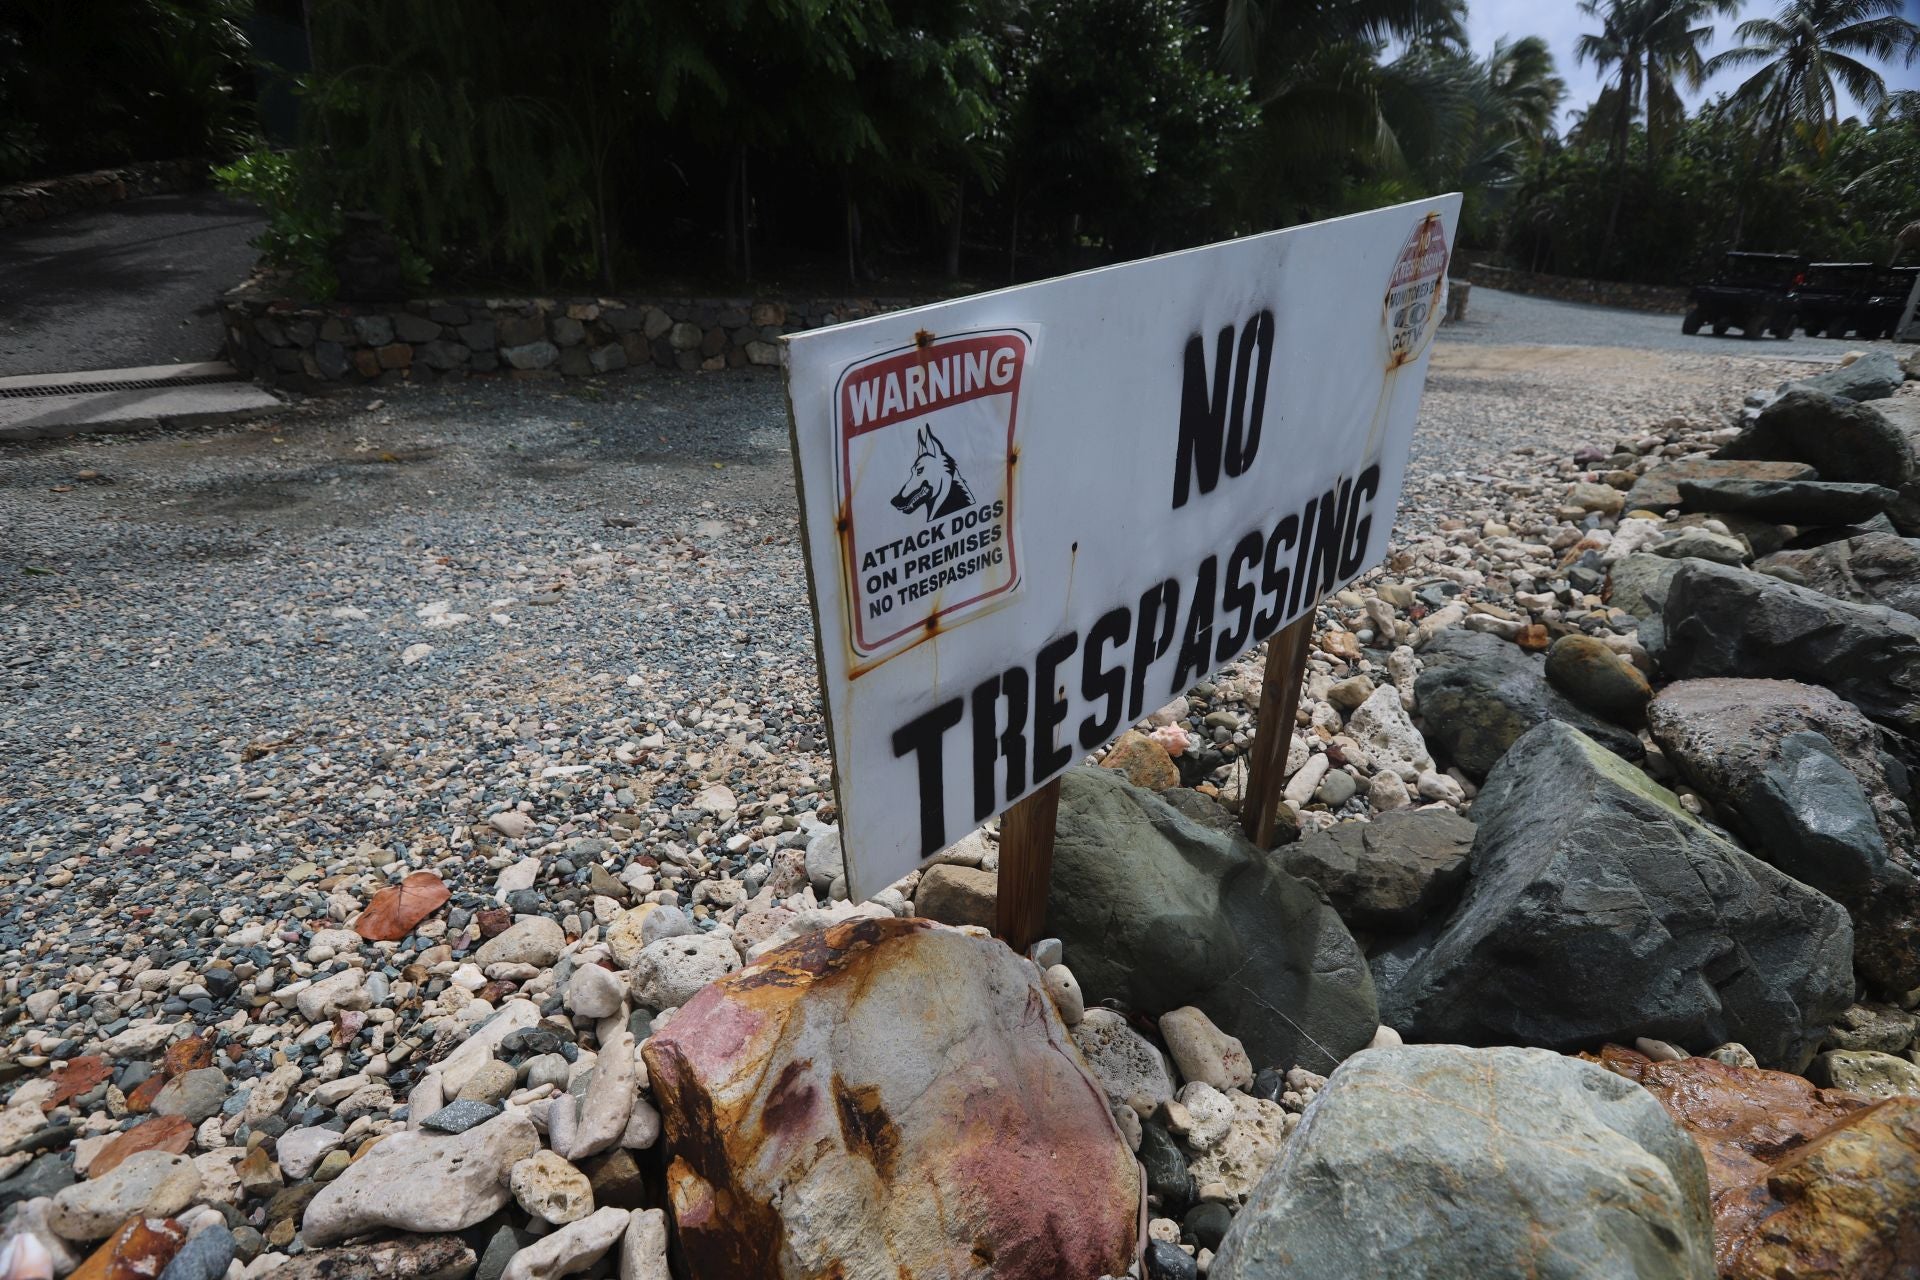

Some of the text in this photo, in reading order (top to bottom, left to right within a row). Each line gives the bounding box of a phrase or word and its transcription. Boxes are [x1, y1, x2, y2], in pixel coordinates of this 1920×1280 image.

[1419, 231, 1431, 251] NO
[1390, 282, 1429, 308] MONITORED
[1392, 325, 1423, 351] CCTV
[849, 347, 1016, 427] WARNING
[1172, 310, 1276, 509] NO
[861, 500, 1004, 573] ATTACK DOGS
[866, 524, 1003, 594] ON PREMISES
[869, 547, 1003, 619] NO TRESPASSING
[892, 464, 1381, 859] TRESPASSING
